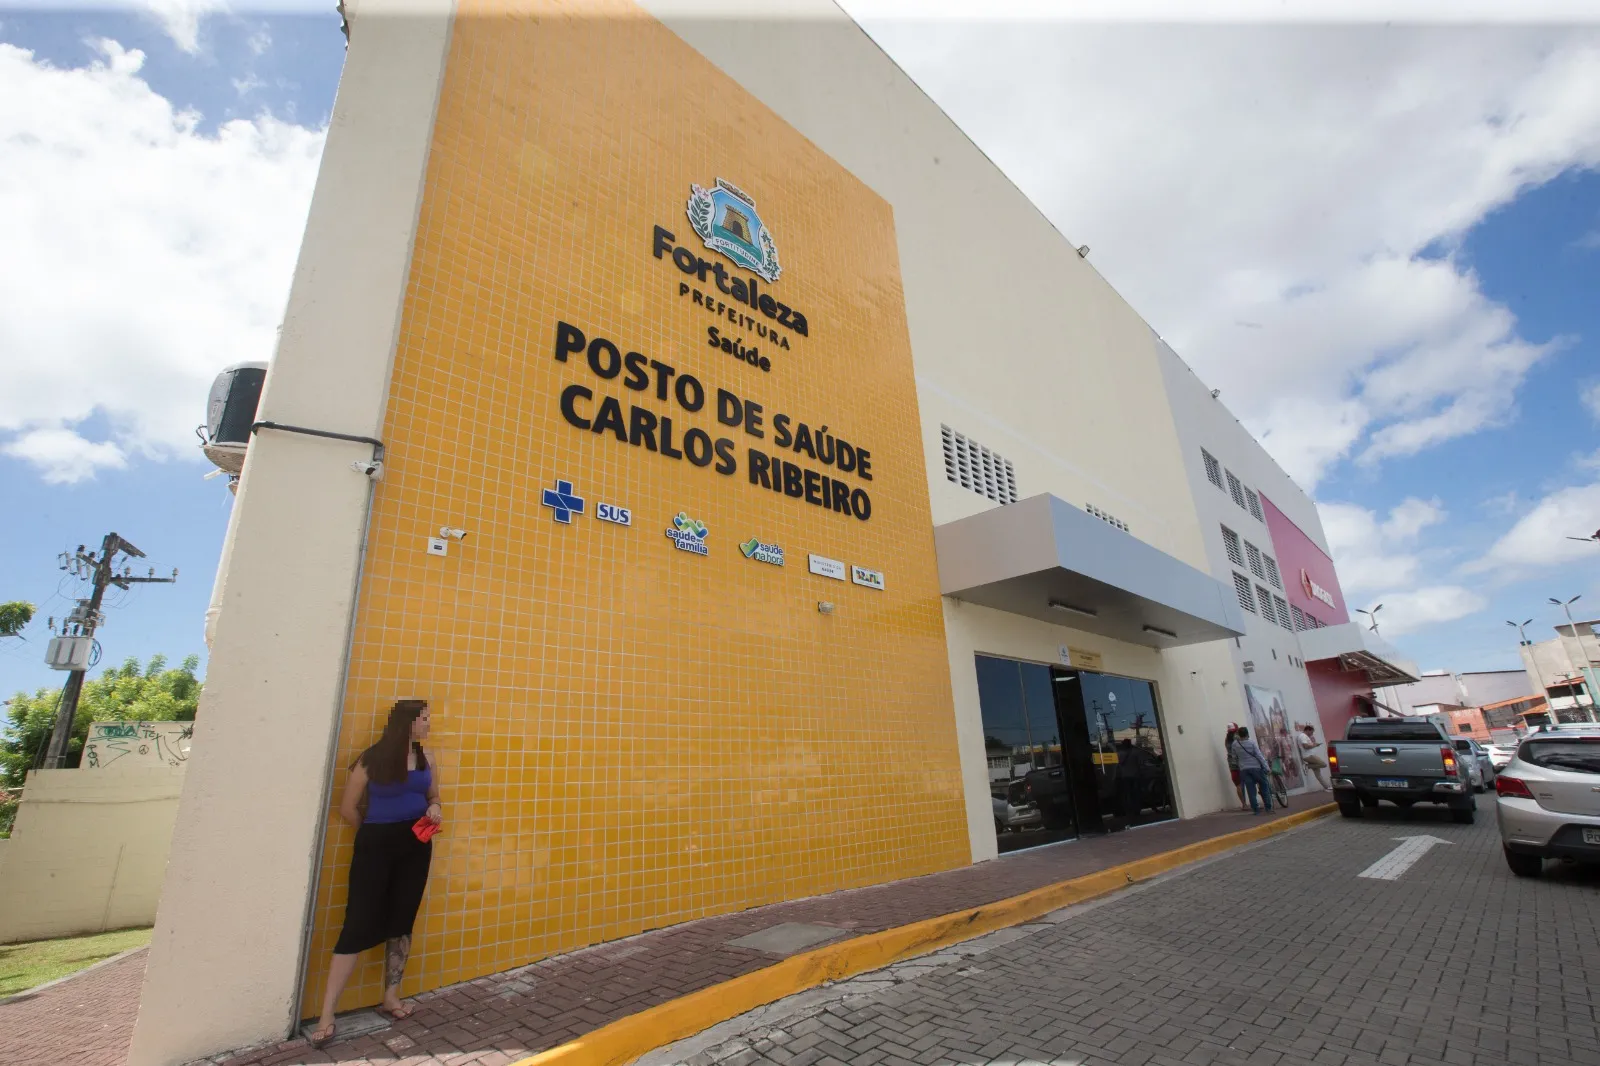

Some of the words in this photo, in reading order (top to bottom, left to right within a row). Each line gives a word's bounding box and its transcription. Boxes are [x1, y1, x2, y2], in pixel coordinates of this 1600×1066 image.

[653, 224, 808, 337] Fortaleza
[679, 282, 790, 350] PREFEITURA
[707, 326, 771, 372] Saúde
[555, 321, 705, 412] POSTO
[717, 388, 764, 439] DE
[773, 414, 873, 481] SAÚDE
[560, 384, 737, 475] CARLOS
[748, 448, 872, 521] RIBEIRO
[599, 504, 629, 523] SUS
[667, 529, 696, 542] saúde
[676, 539, 708, 554] família
[760, 543, 783, 556] saúde
[755, 552, 766, 561] na
[767, 553, 784, 565] hora
